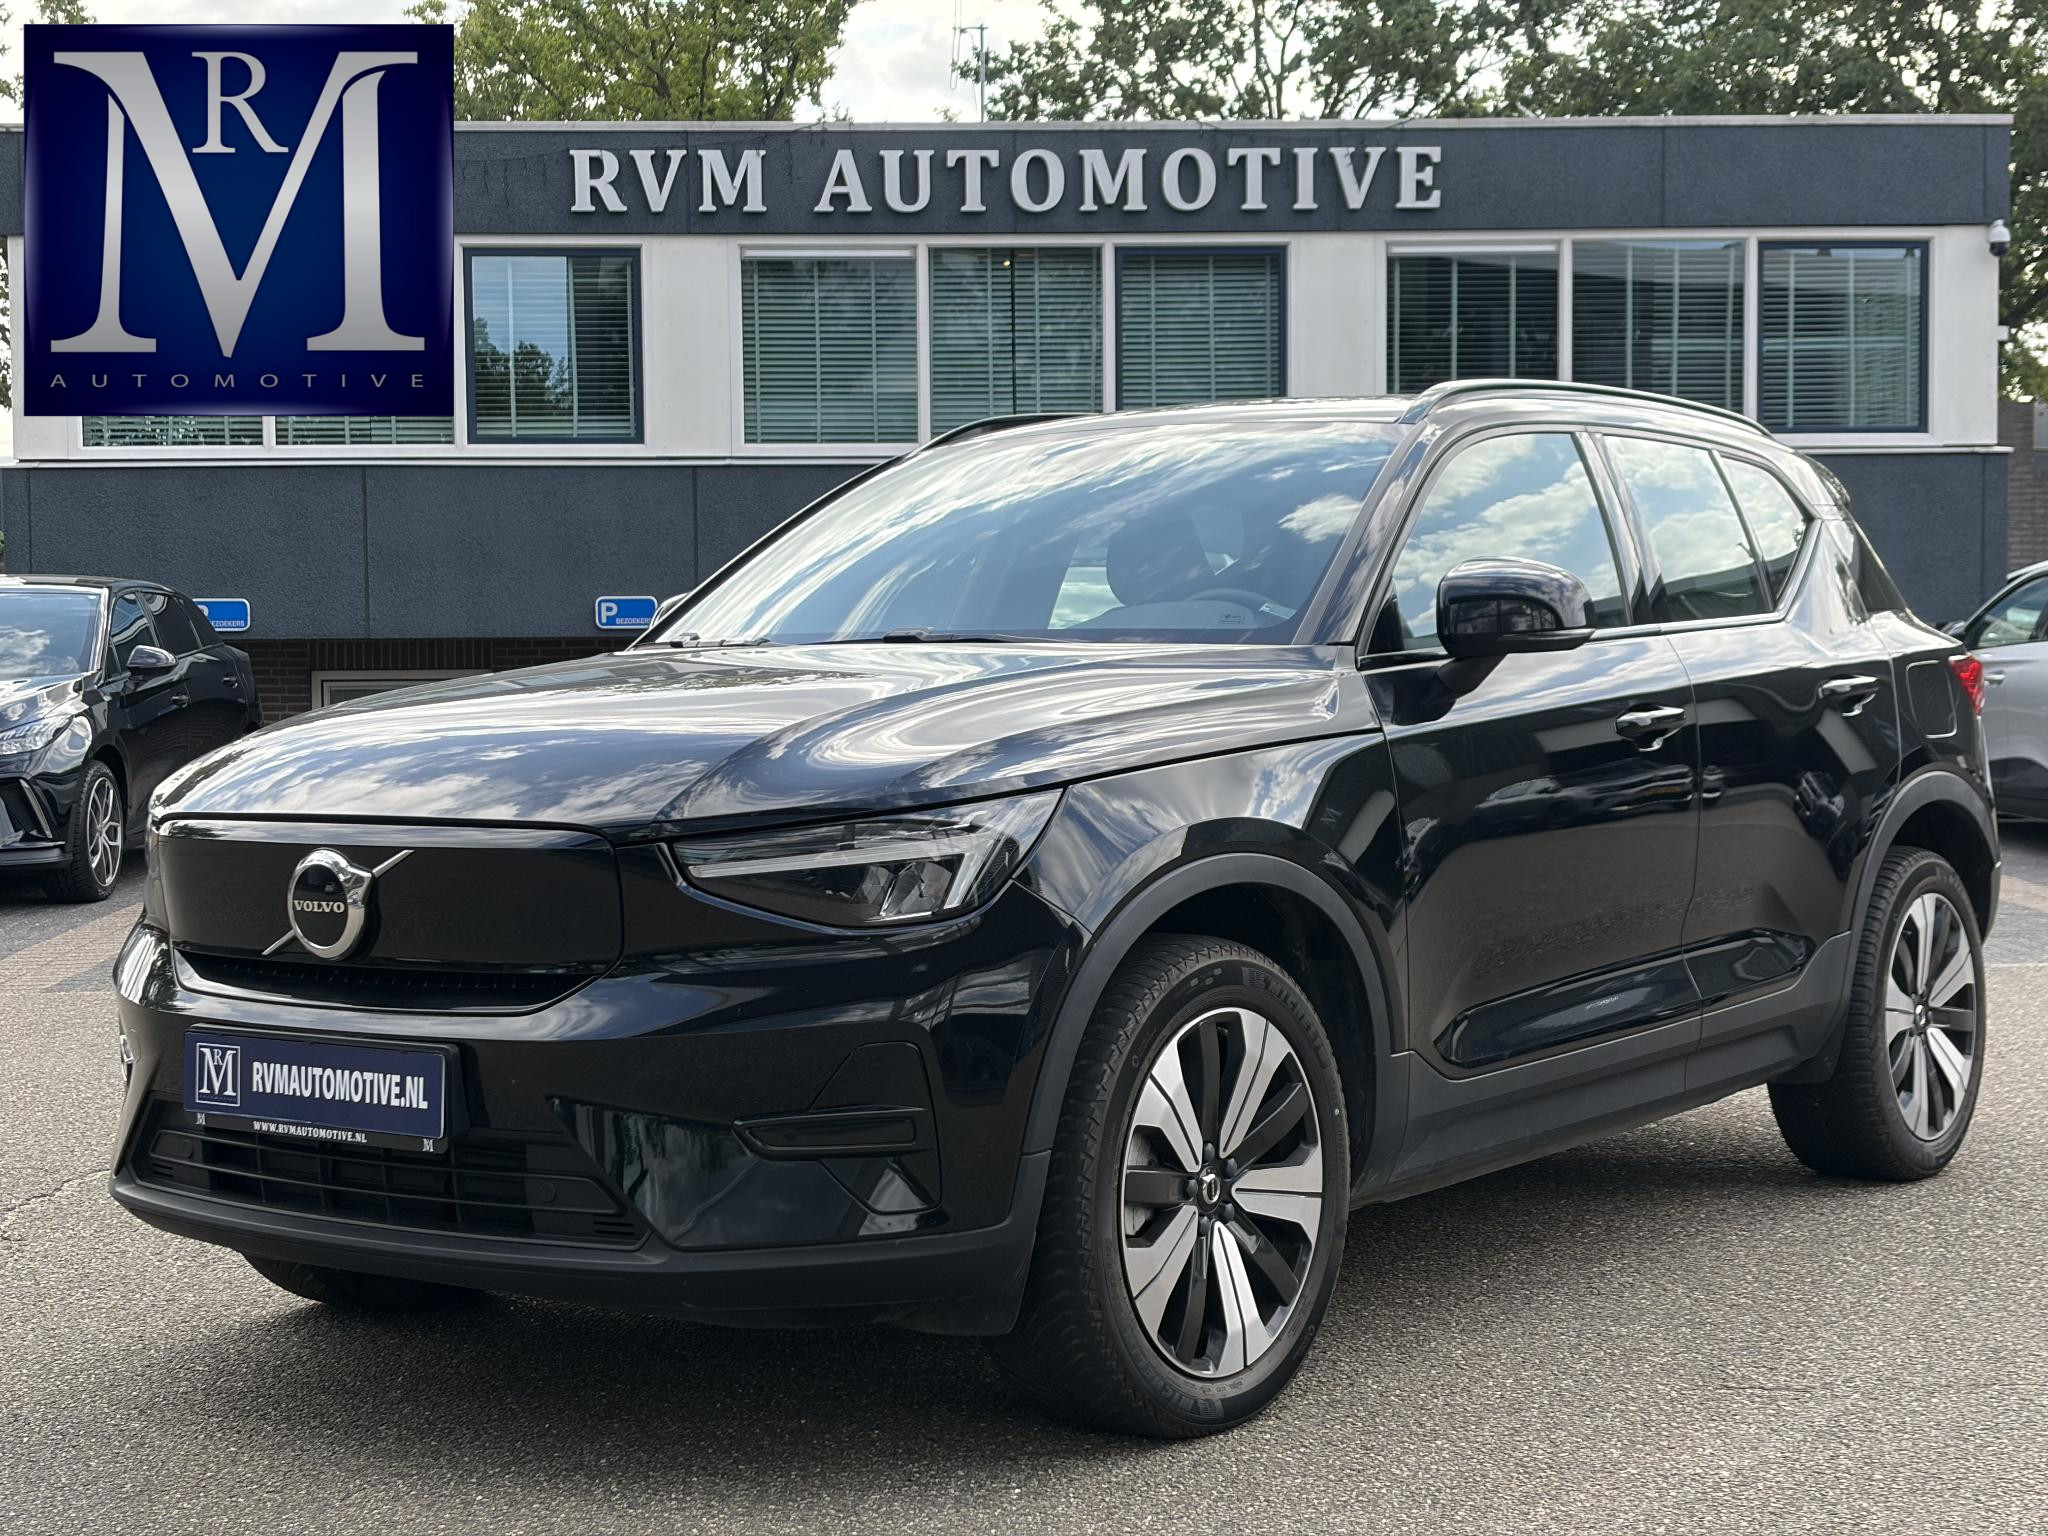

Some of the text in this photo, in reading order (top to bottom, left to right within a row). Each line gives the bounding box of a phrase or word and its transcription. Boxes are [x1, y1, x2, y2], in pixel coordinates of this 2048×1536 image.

[569, 146, 1443, 213] RVM AUTOMOTIVE
[600, 602, 618, 624] P
[294, 900, 345, 913] VOLVO
[252, 1061, 428, 1109] RVMAUTOMOTIVE.NL
[253, 1121, 367, 1143] WWW.RVMAUTOMOTIVE.NL
